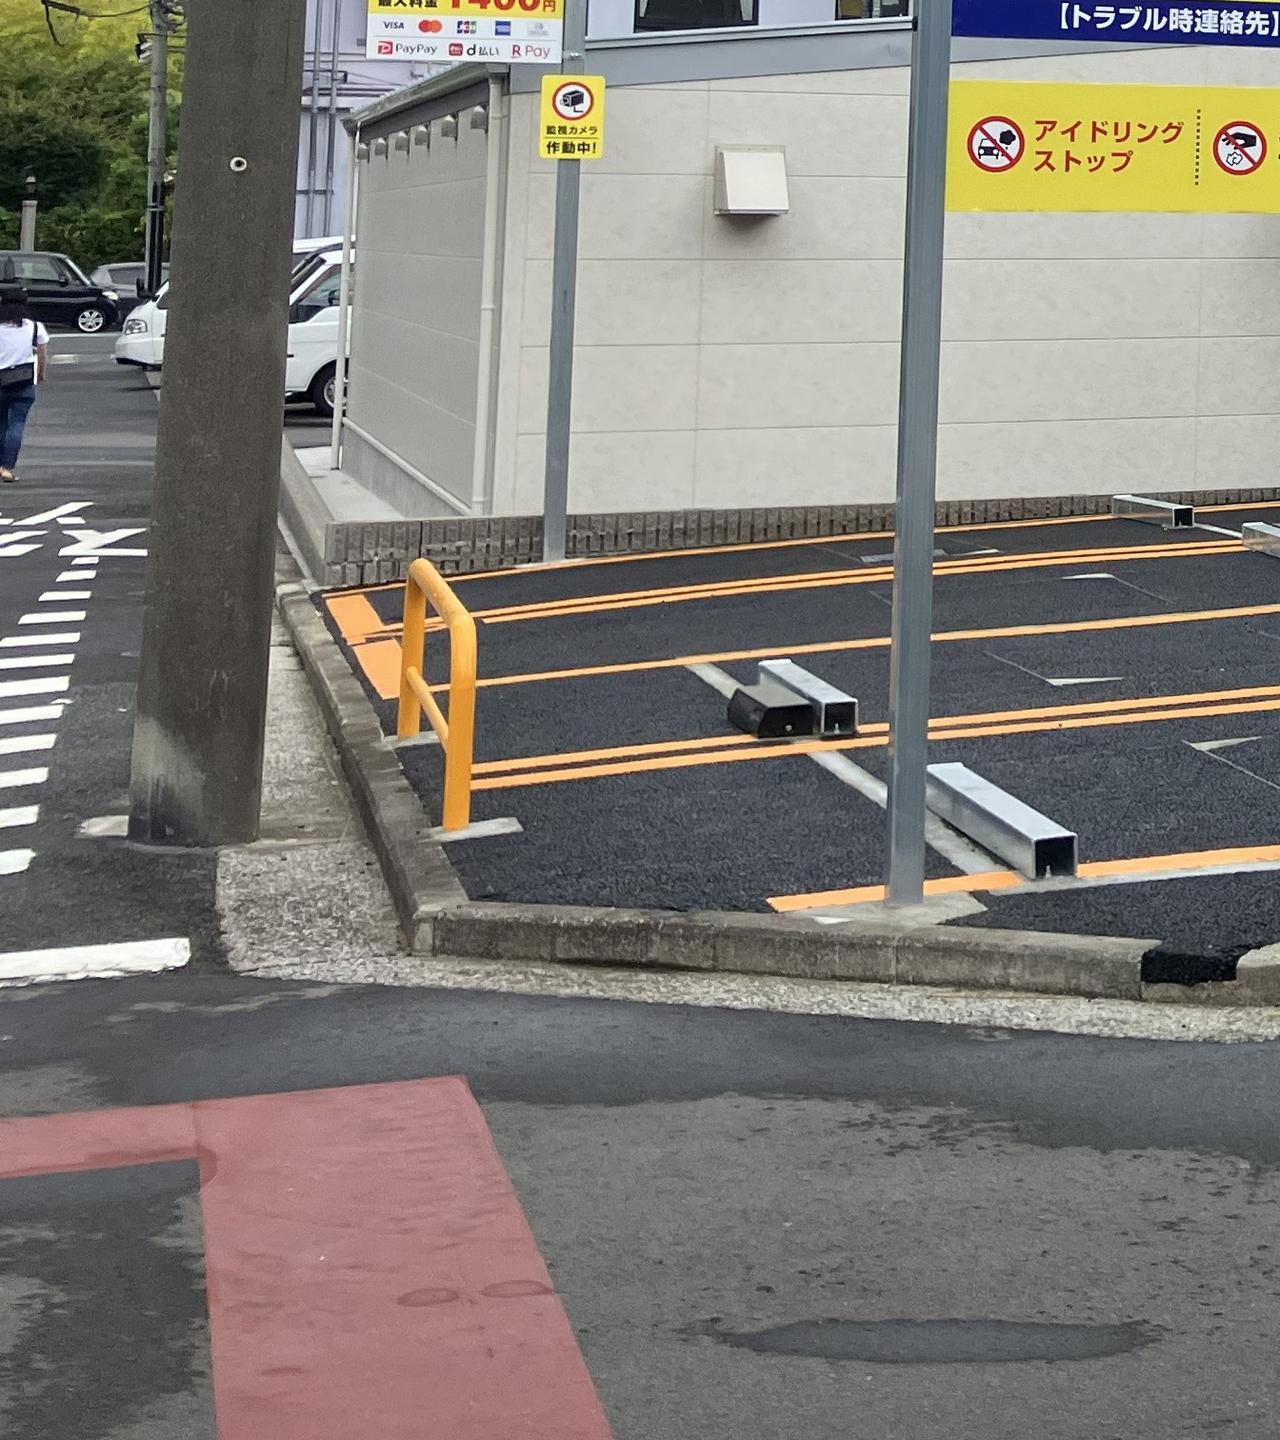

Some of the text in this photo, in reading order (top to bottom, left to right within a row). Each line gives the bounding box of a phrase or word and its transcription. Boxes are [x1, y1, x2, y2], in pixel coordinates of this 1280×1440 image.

[384, 21, 404, 29] VISA
[1060, 2, 1279, 37] 【トラブル時連絡先】
[396, 43, 438, 55] PayPay
[525, 45, 551, 59] Pay
[1034, 120, 1184, 144] アイドリング
[1033, 149, 1133, 173] ストップ
